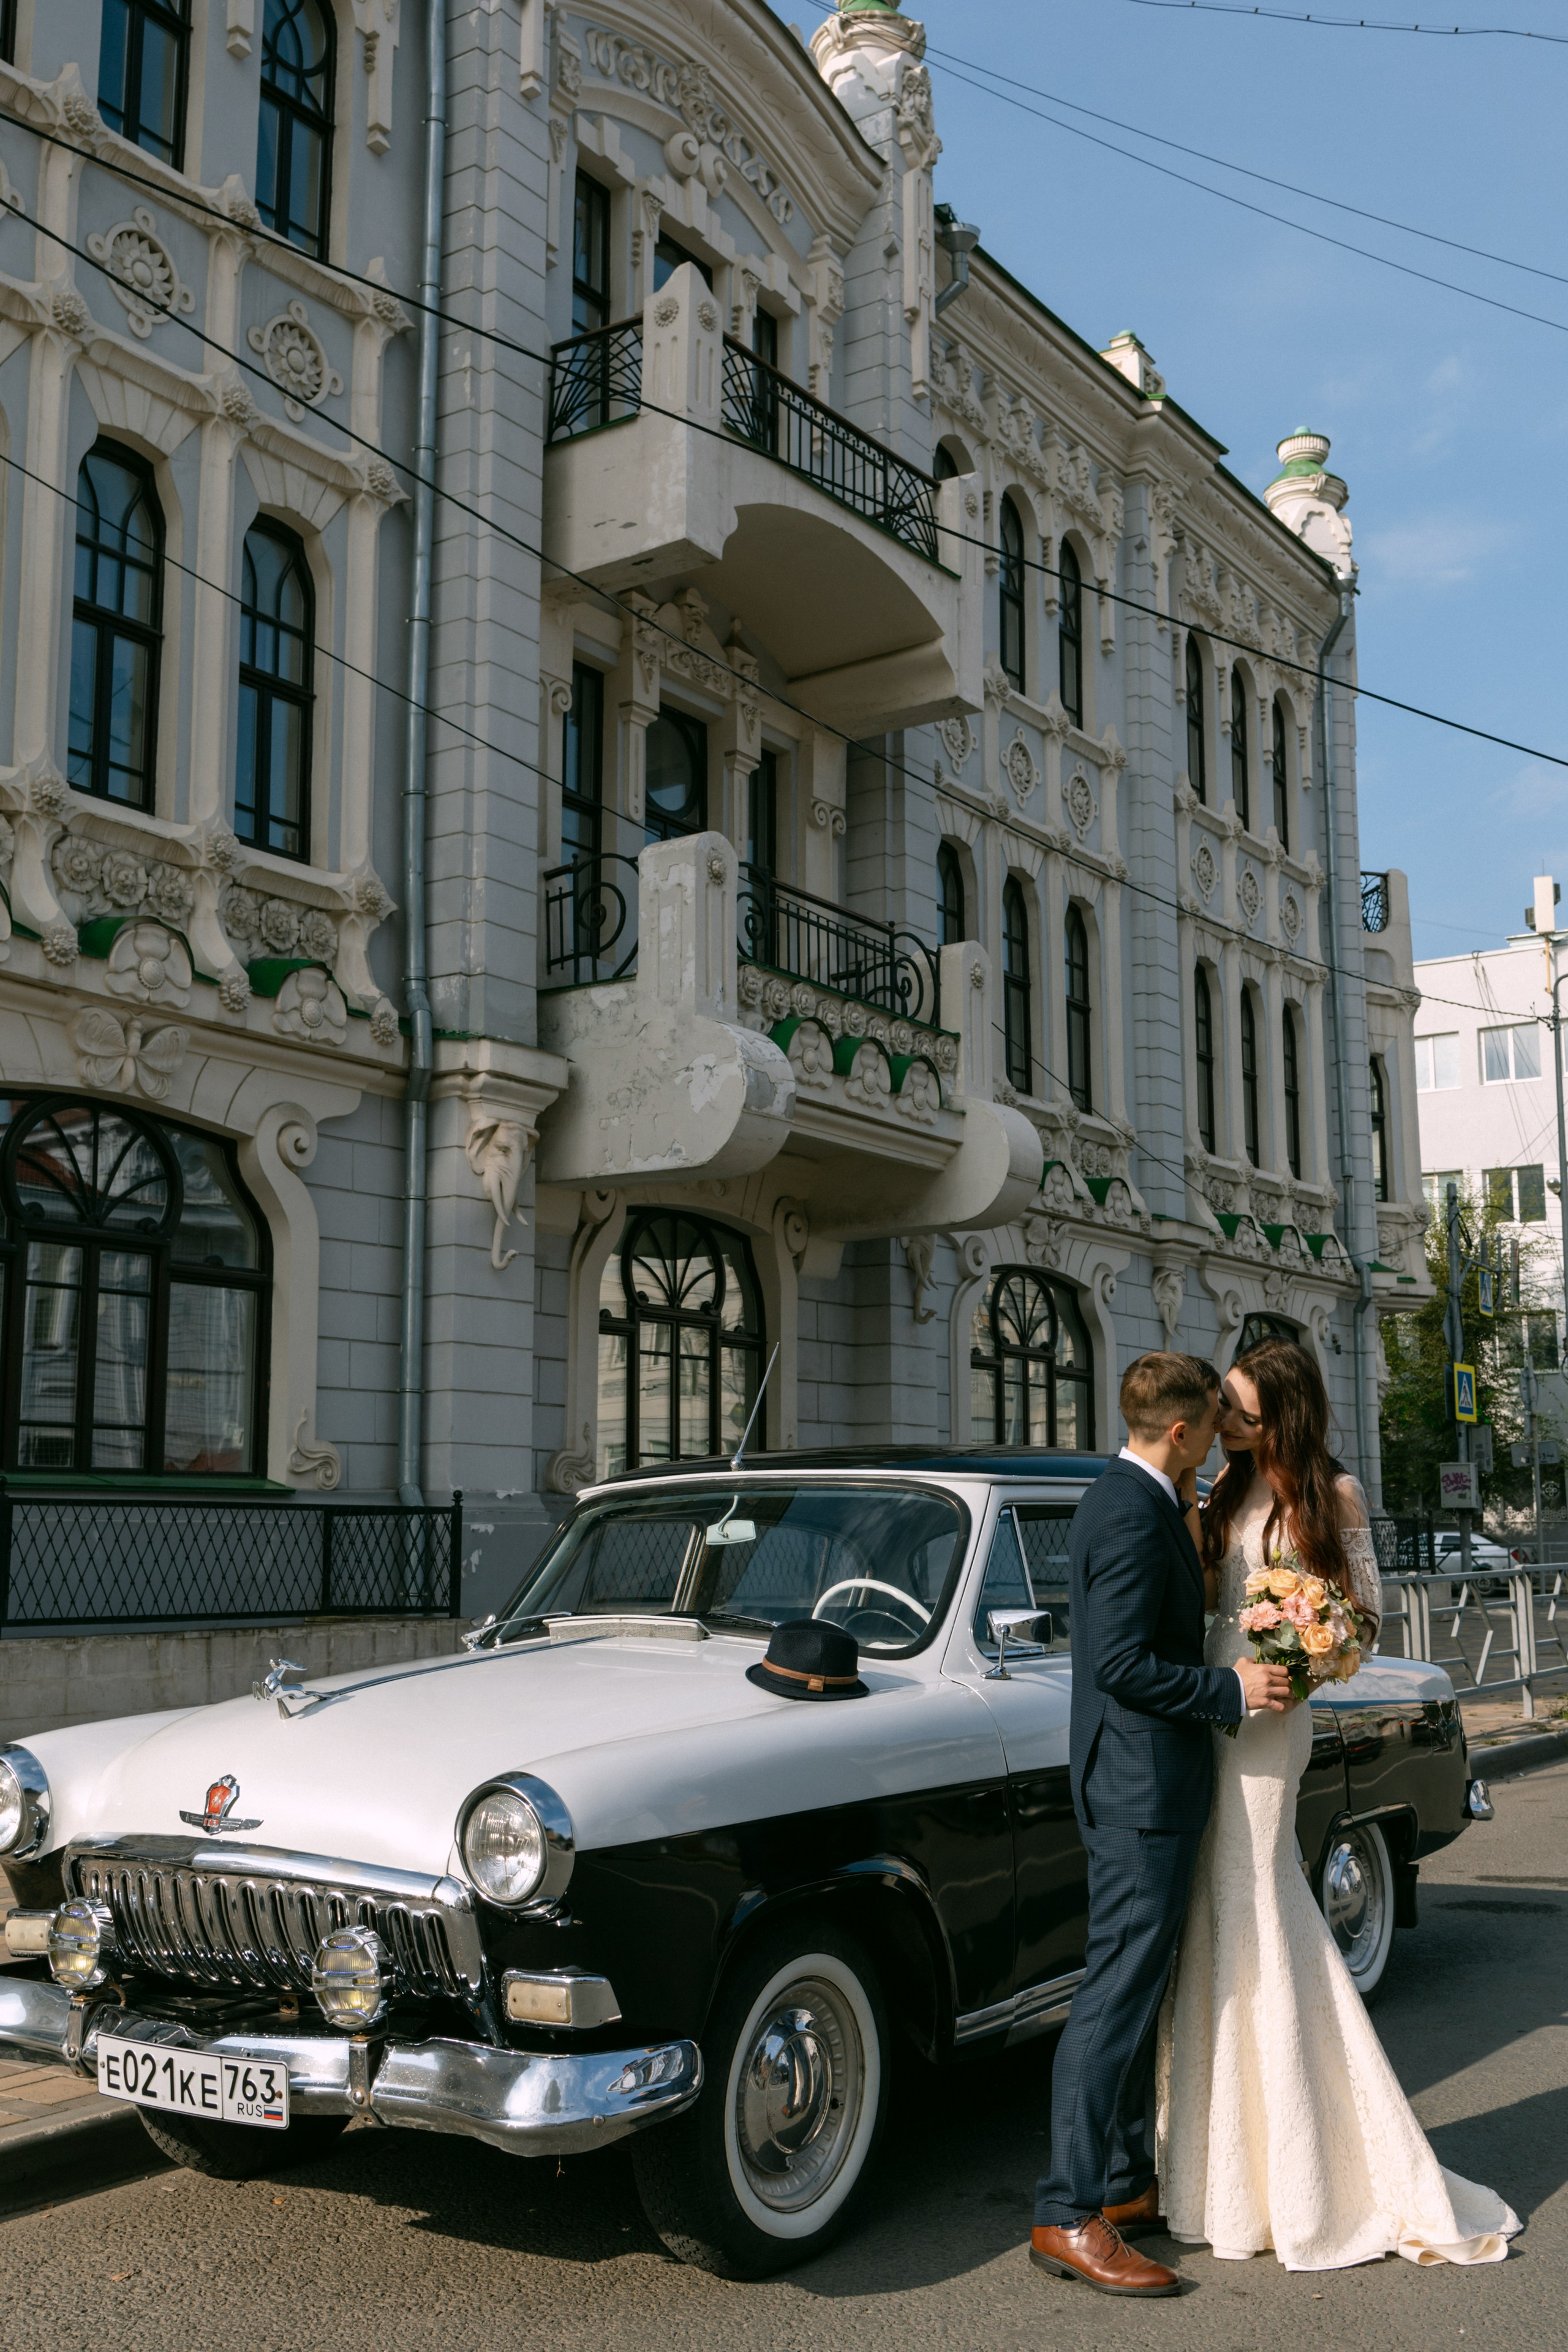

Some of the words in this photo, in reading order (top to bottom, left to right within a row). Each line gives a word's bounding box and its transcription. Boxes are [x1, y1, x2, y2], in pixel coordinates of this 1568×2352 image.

[107, 2049, 217, 2109] E021KE
[224, 2064, 276, 2103] 763
[238, 2102, 263, 2117] RUS
